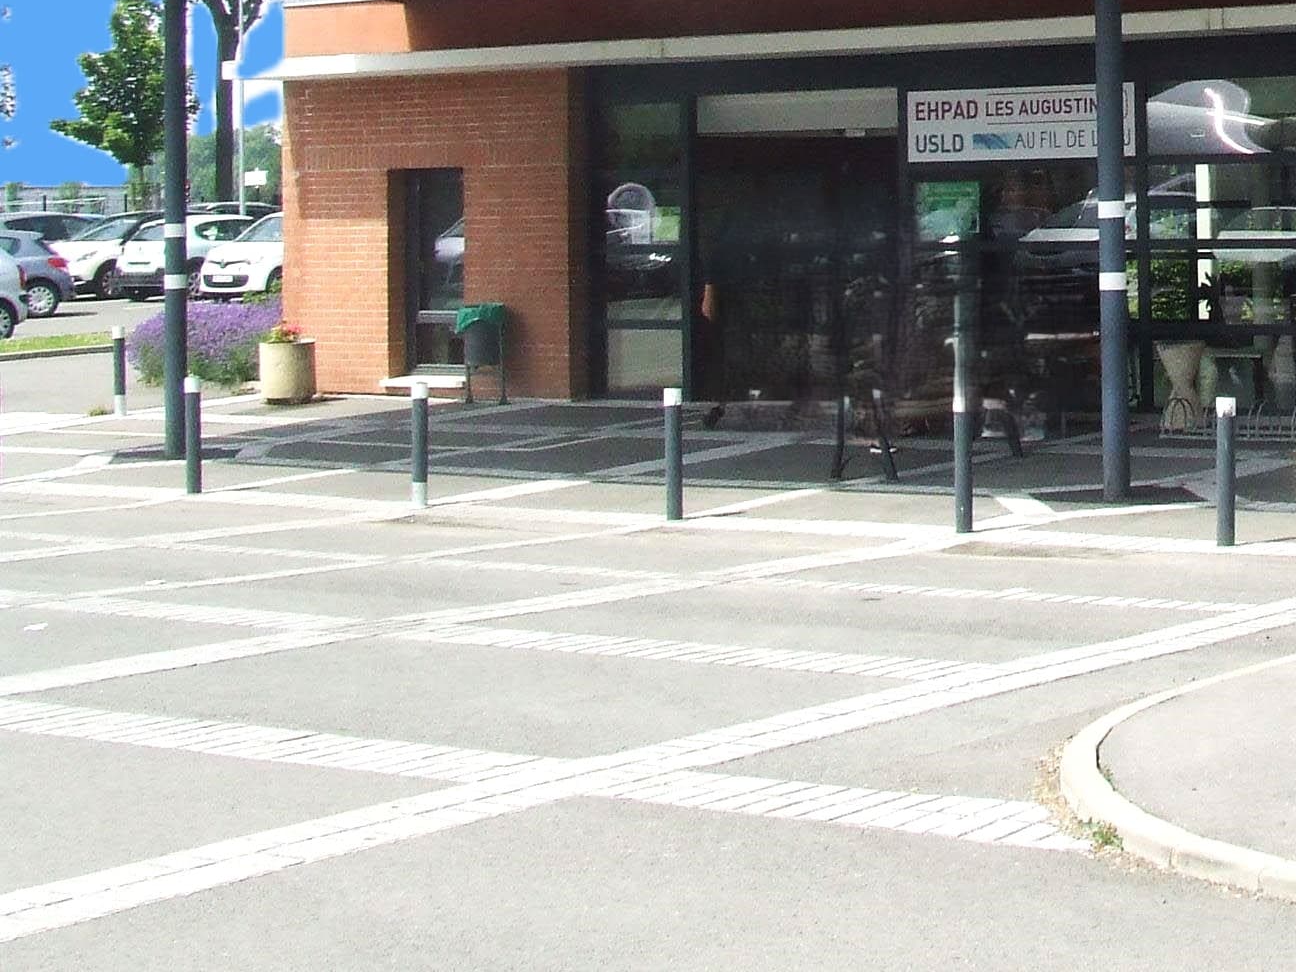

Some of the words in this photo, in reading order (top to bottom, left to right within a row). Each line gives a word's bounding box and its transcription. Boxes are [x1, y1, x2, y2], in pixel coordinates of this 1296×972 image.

[915, 100, 979, 121] EHPAD
[986, 100, 1014, 117] LES
[915, 134, 964, 154] USLD
[1015, 131, 1035, 150] AU
[1040, 130, 1061, 149] FIL
[1066, 129, 1086, 148] DE
